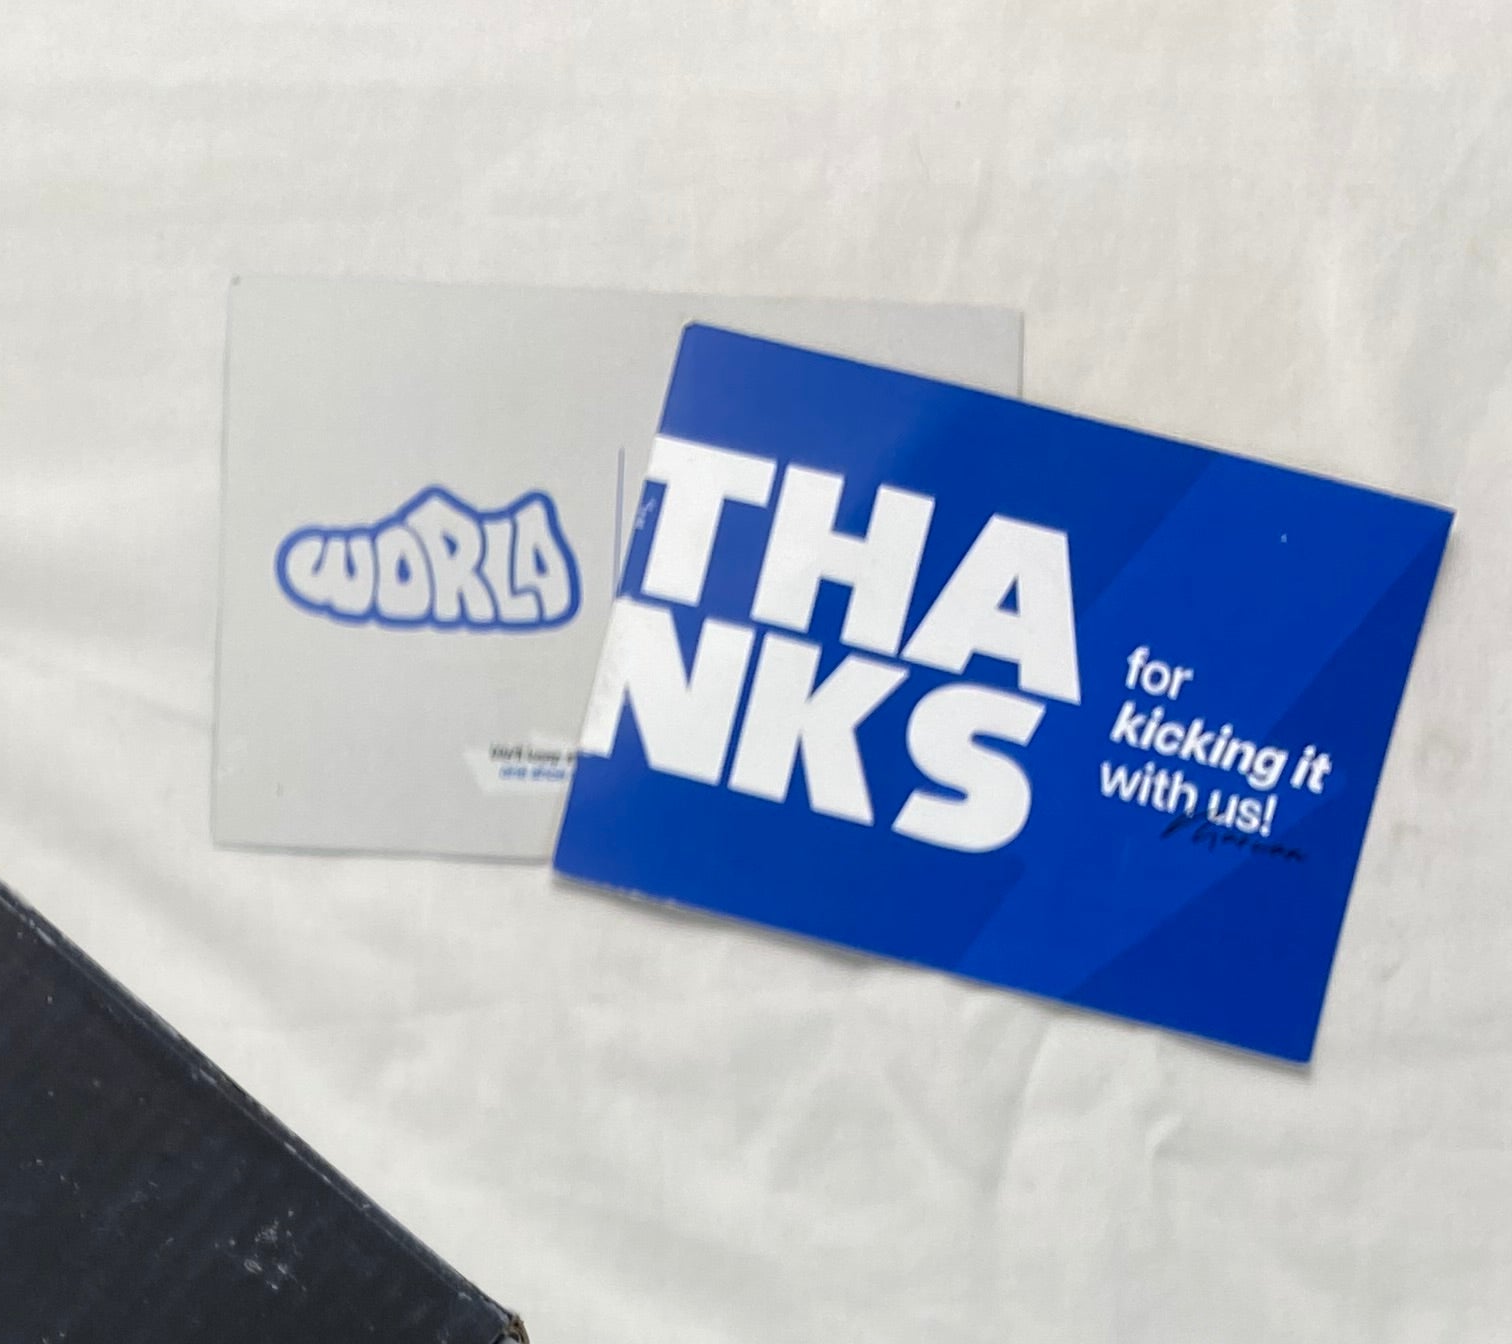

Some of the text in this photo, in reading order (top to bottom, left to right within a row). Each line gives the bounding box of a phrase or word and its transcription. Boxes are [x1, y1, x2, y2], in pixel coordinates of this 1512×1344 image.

[639, 432, 1082, 706] THA
[1124, 645, 1194, 700] for
[578, 595, 1046, 854] NKS
[1109, 700, 1332, 794] kicking it
[1099, 760, 1199, 818] with
[1206, 789, 1279, 838] us!
